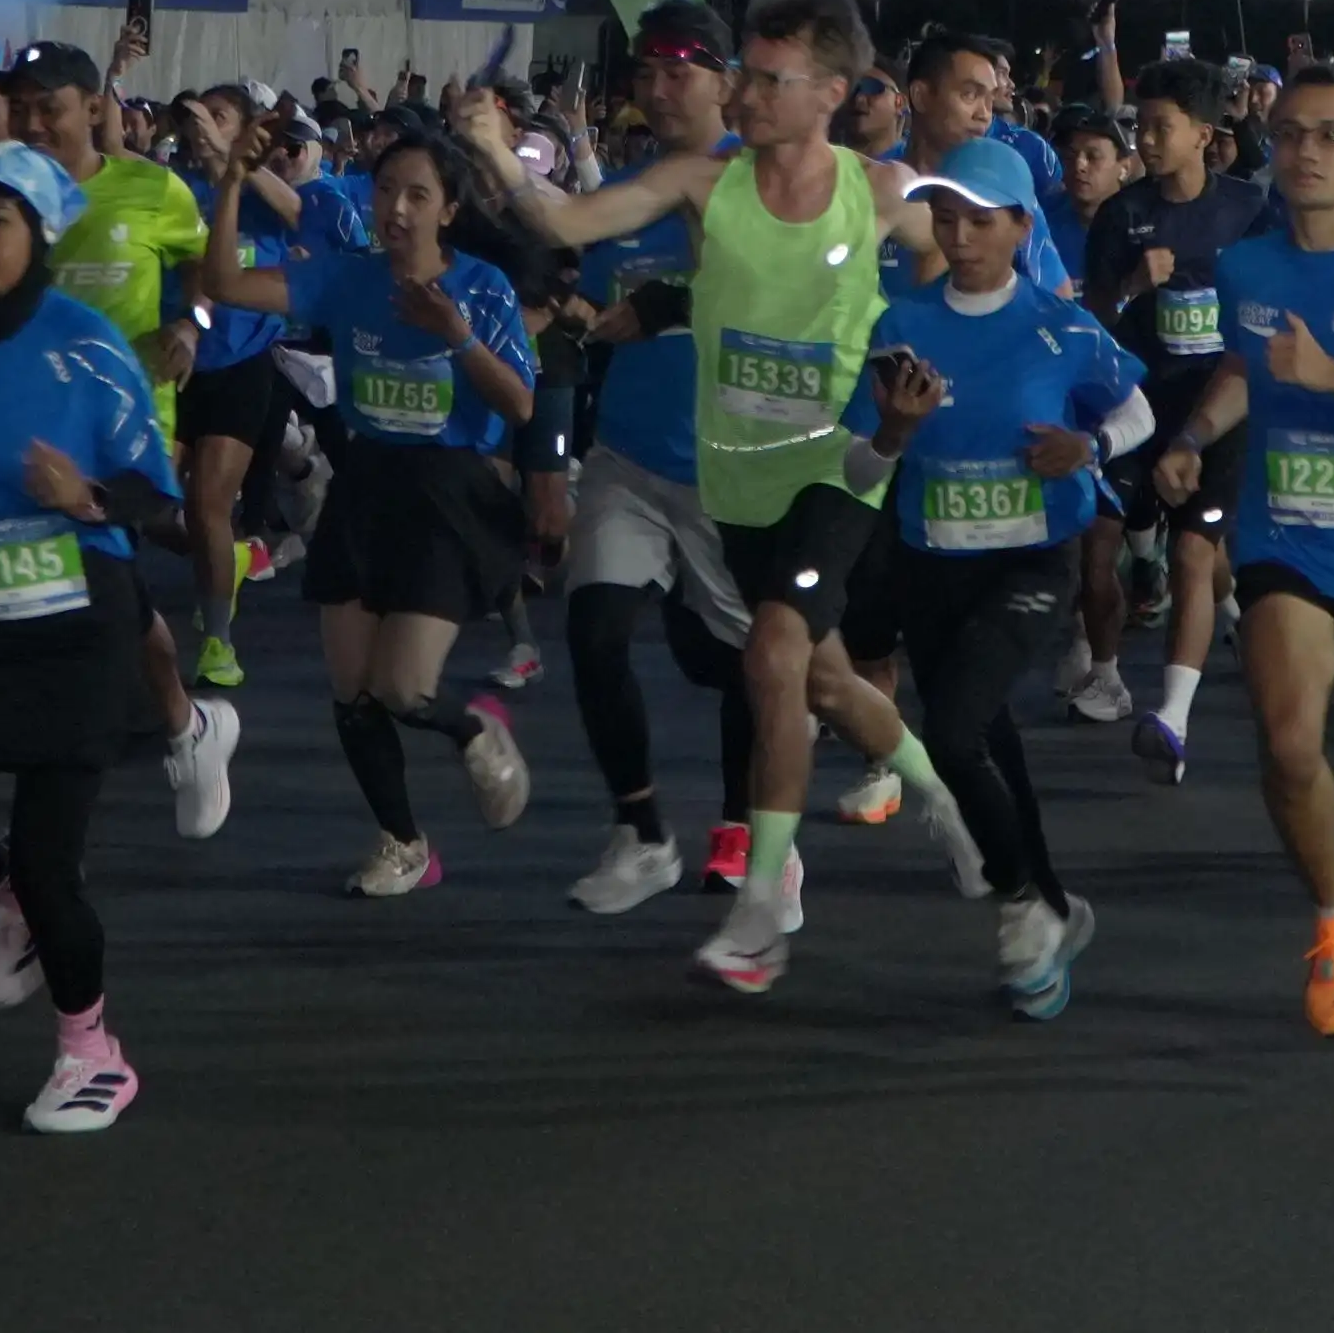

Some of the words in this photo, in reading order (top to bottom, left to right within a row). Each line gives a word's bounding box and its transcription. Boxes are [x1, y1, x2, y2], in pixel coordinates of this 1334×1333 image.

[365, 378, 438, 410] 11755
[728, 354, 821, 397] 15339
[936, 479, 1029, 518] 15367
